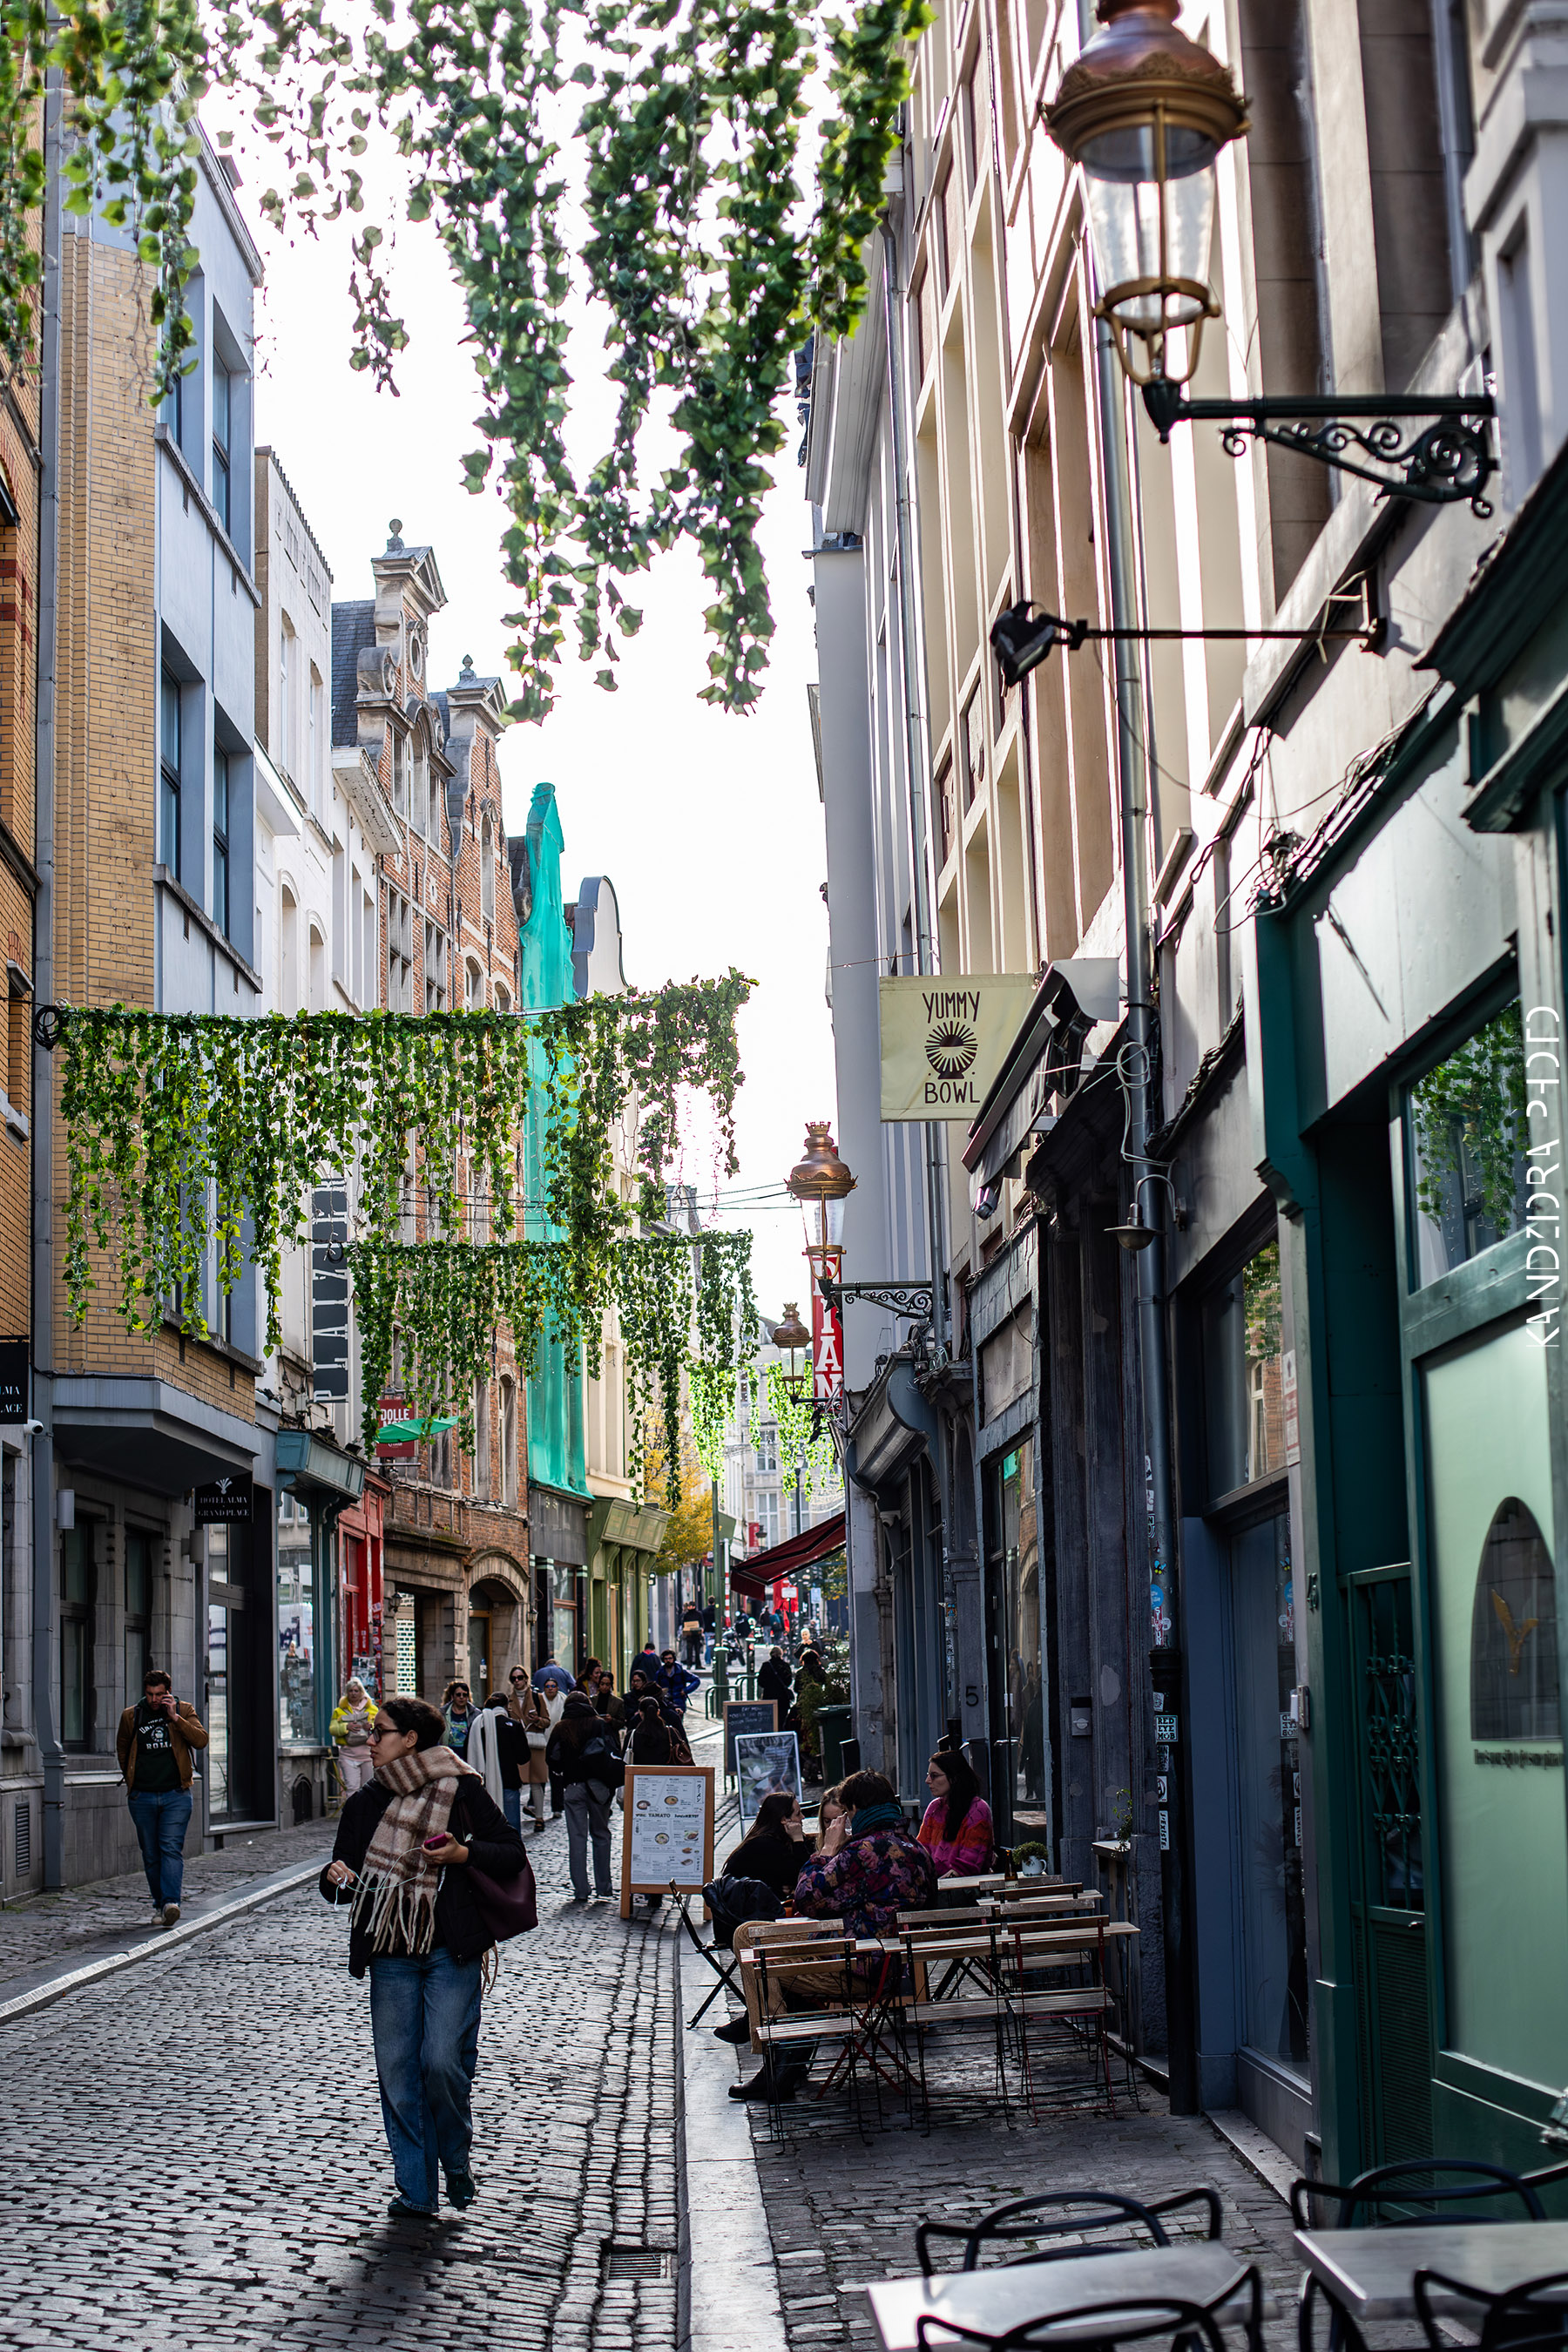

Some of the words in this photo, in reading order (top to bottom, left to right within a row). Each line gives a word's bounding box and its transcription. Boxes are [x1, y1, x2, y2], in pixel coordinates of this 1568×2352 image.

[922, 990, 980, 1024] YUMMY
[924, 1081, 980, 1104] BOWL
[381, 1408, 410, 1421] DOLLE
[965, 1686, 979, 1707] 5
